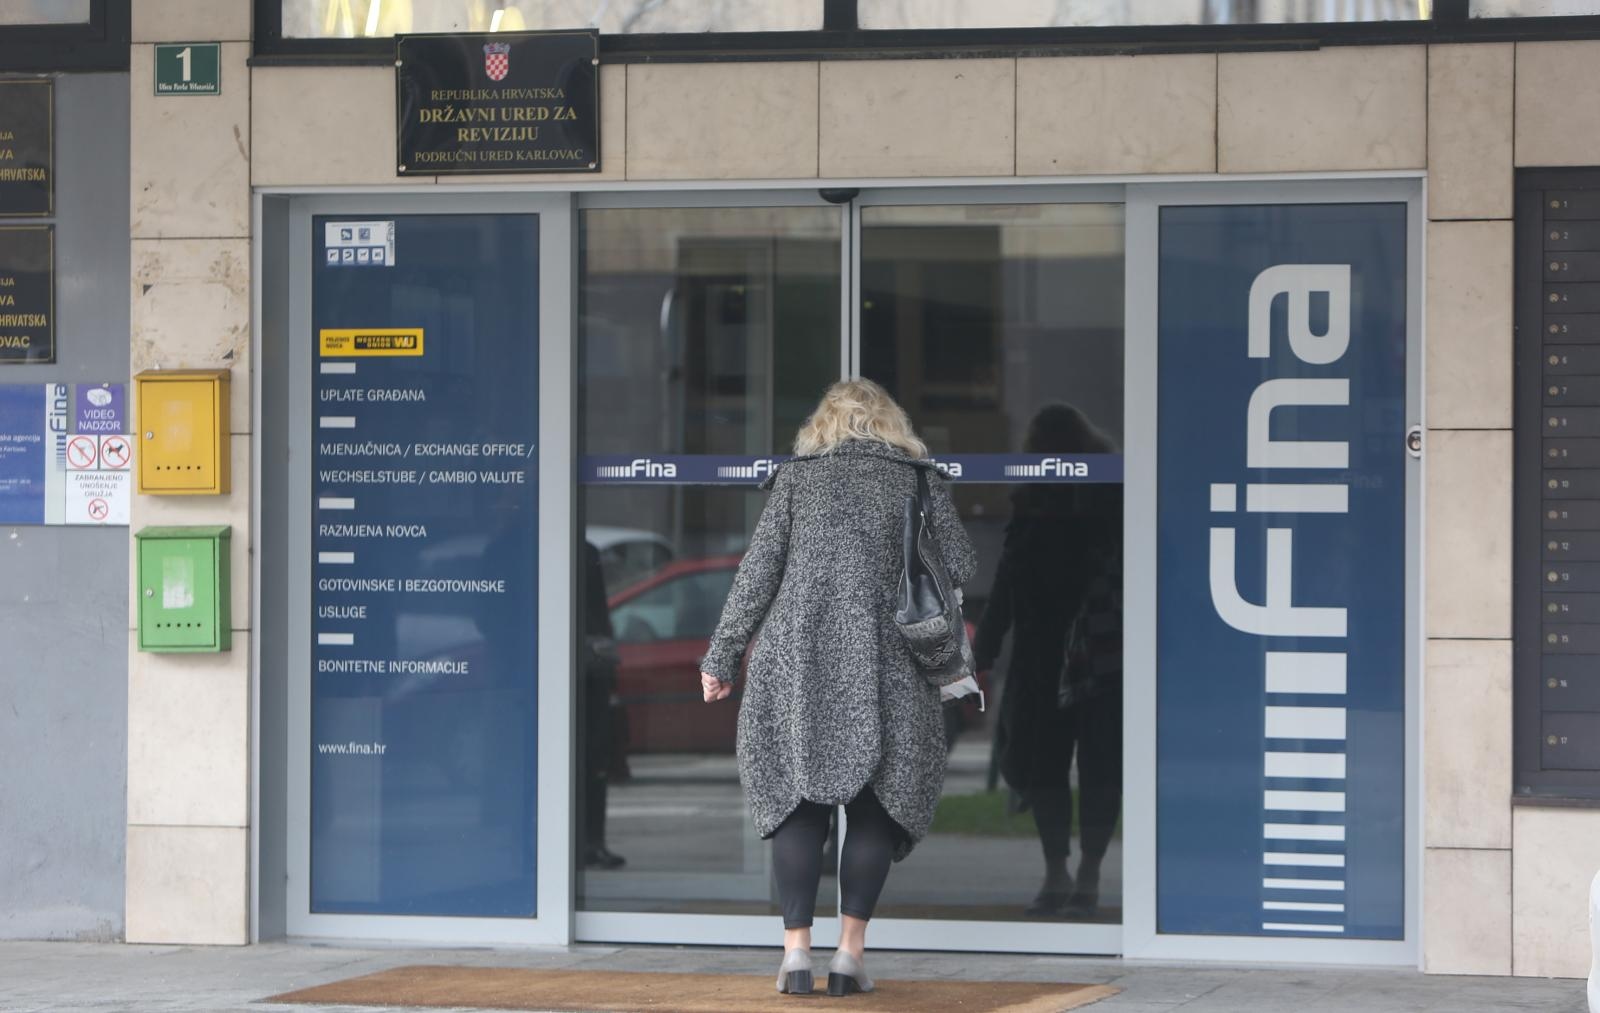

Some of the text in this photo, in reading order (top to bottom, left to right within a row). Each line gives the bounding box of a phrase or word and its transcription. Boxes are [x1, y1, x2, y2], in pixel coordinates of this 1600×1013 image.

[176, 47, 191, 81] 1
[431, 88, 564, 101] REPUBLIKA HRVATSKA
[419, 105, 577, 123] DRŽAVNI URED ZA
[457, 127, 539, 142] REVIZIJU
[415, 149, 583, 163] PODRUČNI URED KARLOVAC
[0, 314, 47, 327] HRVATSKA
[320, 388, 426, 402] UPLATE GRAĐANA
[84, 409, 115, 419] VIDEO
[79, 421, 121, 431] NADZOR
[320, 440, 535, 458] MJENJAČNICA / EXCHANGE OFFICE /
[319, 470, 525, 486] WECHSELSTUBE / CAMBIO VALUTE
[319, 525, 427, 538] RAZMJENA NOVCA
[318, 579, 505, 593] GOTOVINSKE I BEZGOTOVINSKE
[318, 606, 367, 619] USLUGE
[318, 660, 469, 675] BONITETNE INFORMACIJE
[318, 742, 387, 756] www.fina.hr
